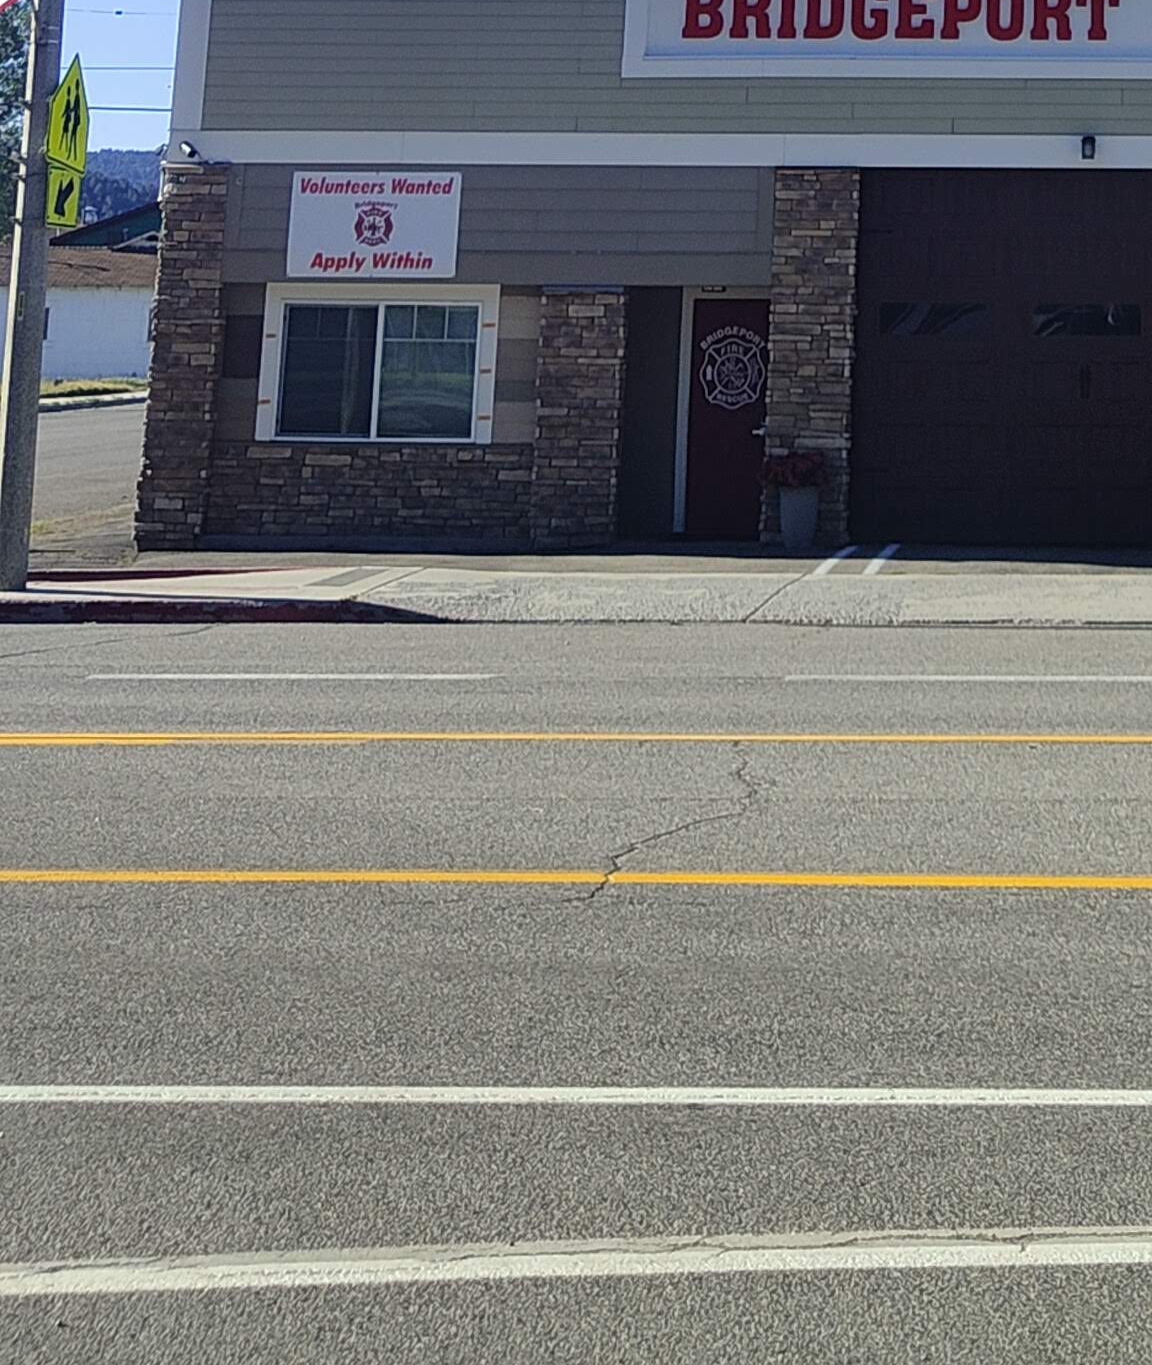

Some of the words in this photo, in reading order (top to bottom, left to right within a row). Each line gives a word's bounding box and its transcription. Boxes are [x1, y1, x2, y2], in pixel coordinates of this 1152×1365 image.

[300, 177, 385, 195] Volunteers
[391, 177, 454, 195] Wanted
[310, 252, 366, 272] Apply
[372, 252, 433, 270] Within
[700, 326, 766, 350] BRIDGEPORT
[720, 344, 744, 355] FIRE
